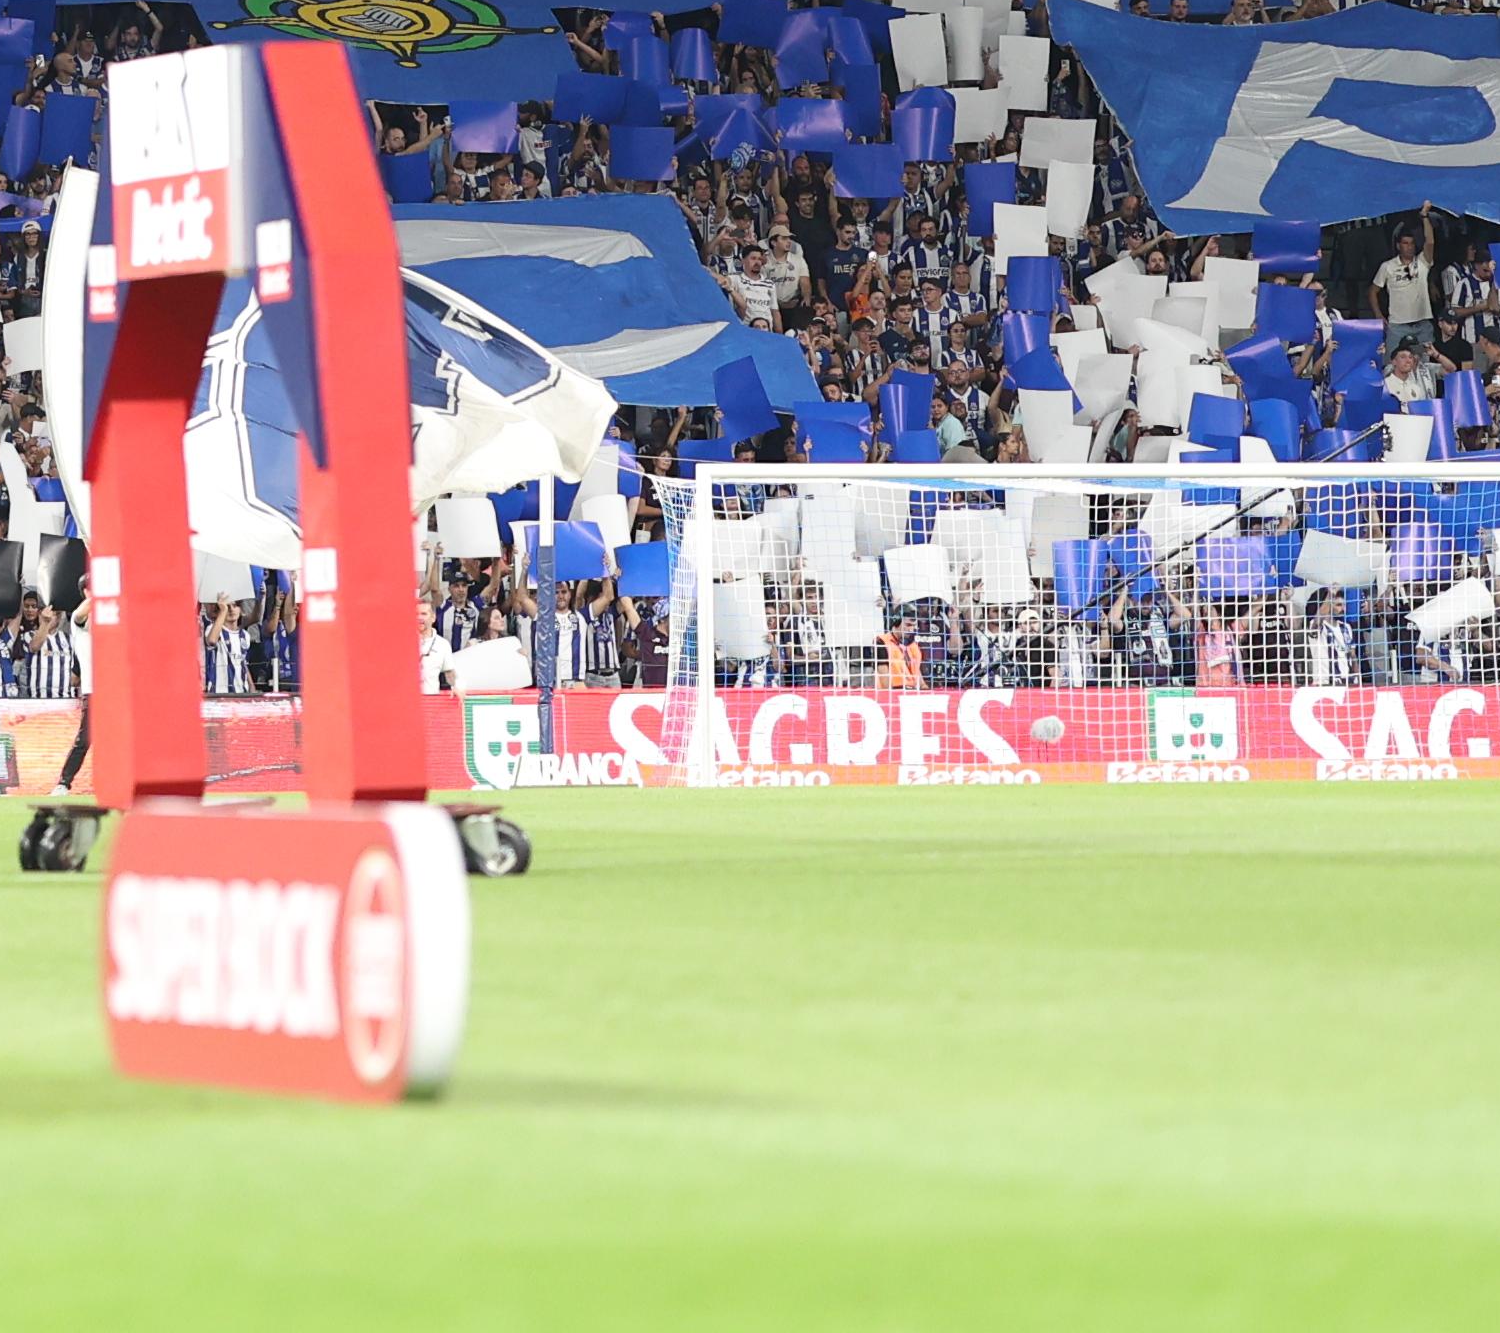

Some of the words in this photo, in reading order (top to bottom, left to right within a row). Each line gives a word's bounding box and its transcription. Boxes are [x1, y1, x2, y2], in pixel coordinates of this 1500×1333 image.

[608, 686, 1022, 766] SAGRES
[899, 763, 1041, 785] Betano
[1106, 761, 1250, 783] Betano
[1315, 759, 1458, 781] Betano
